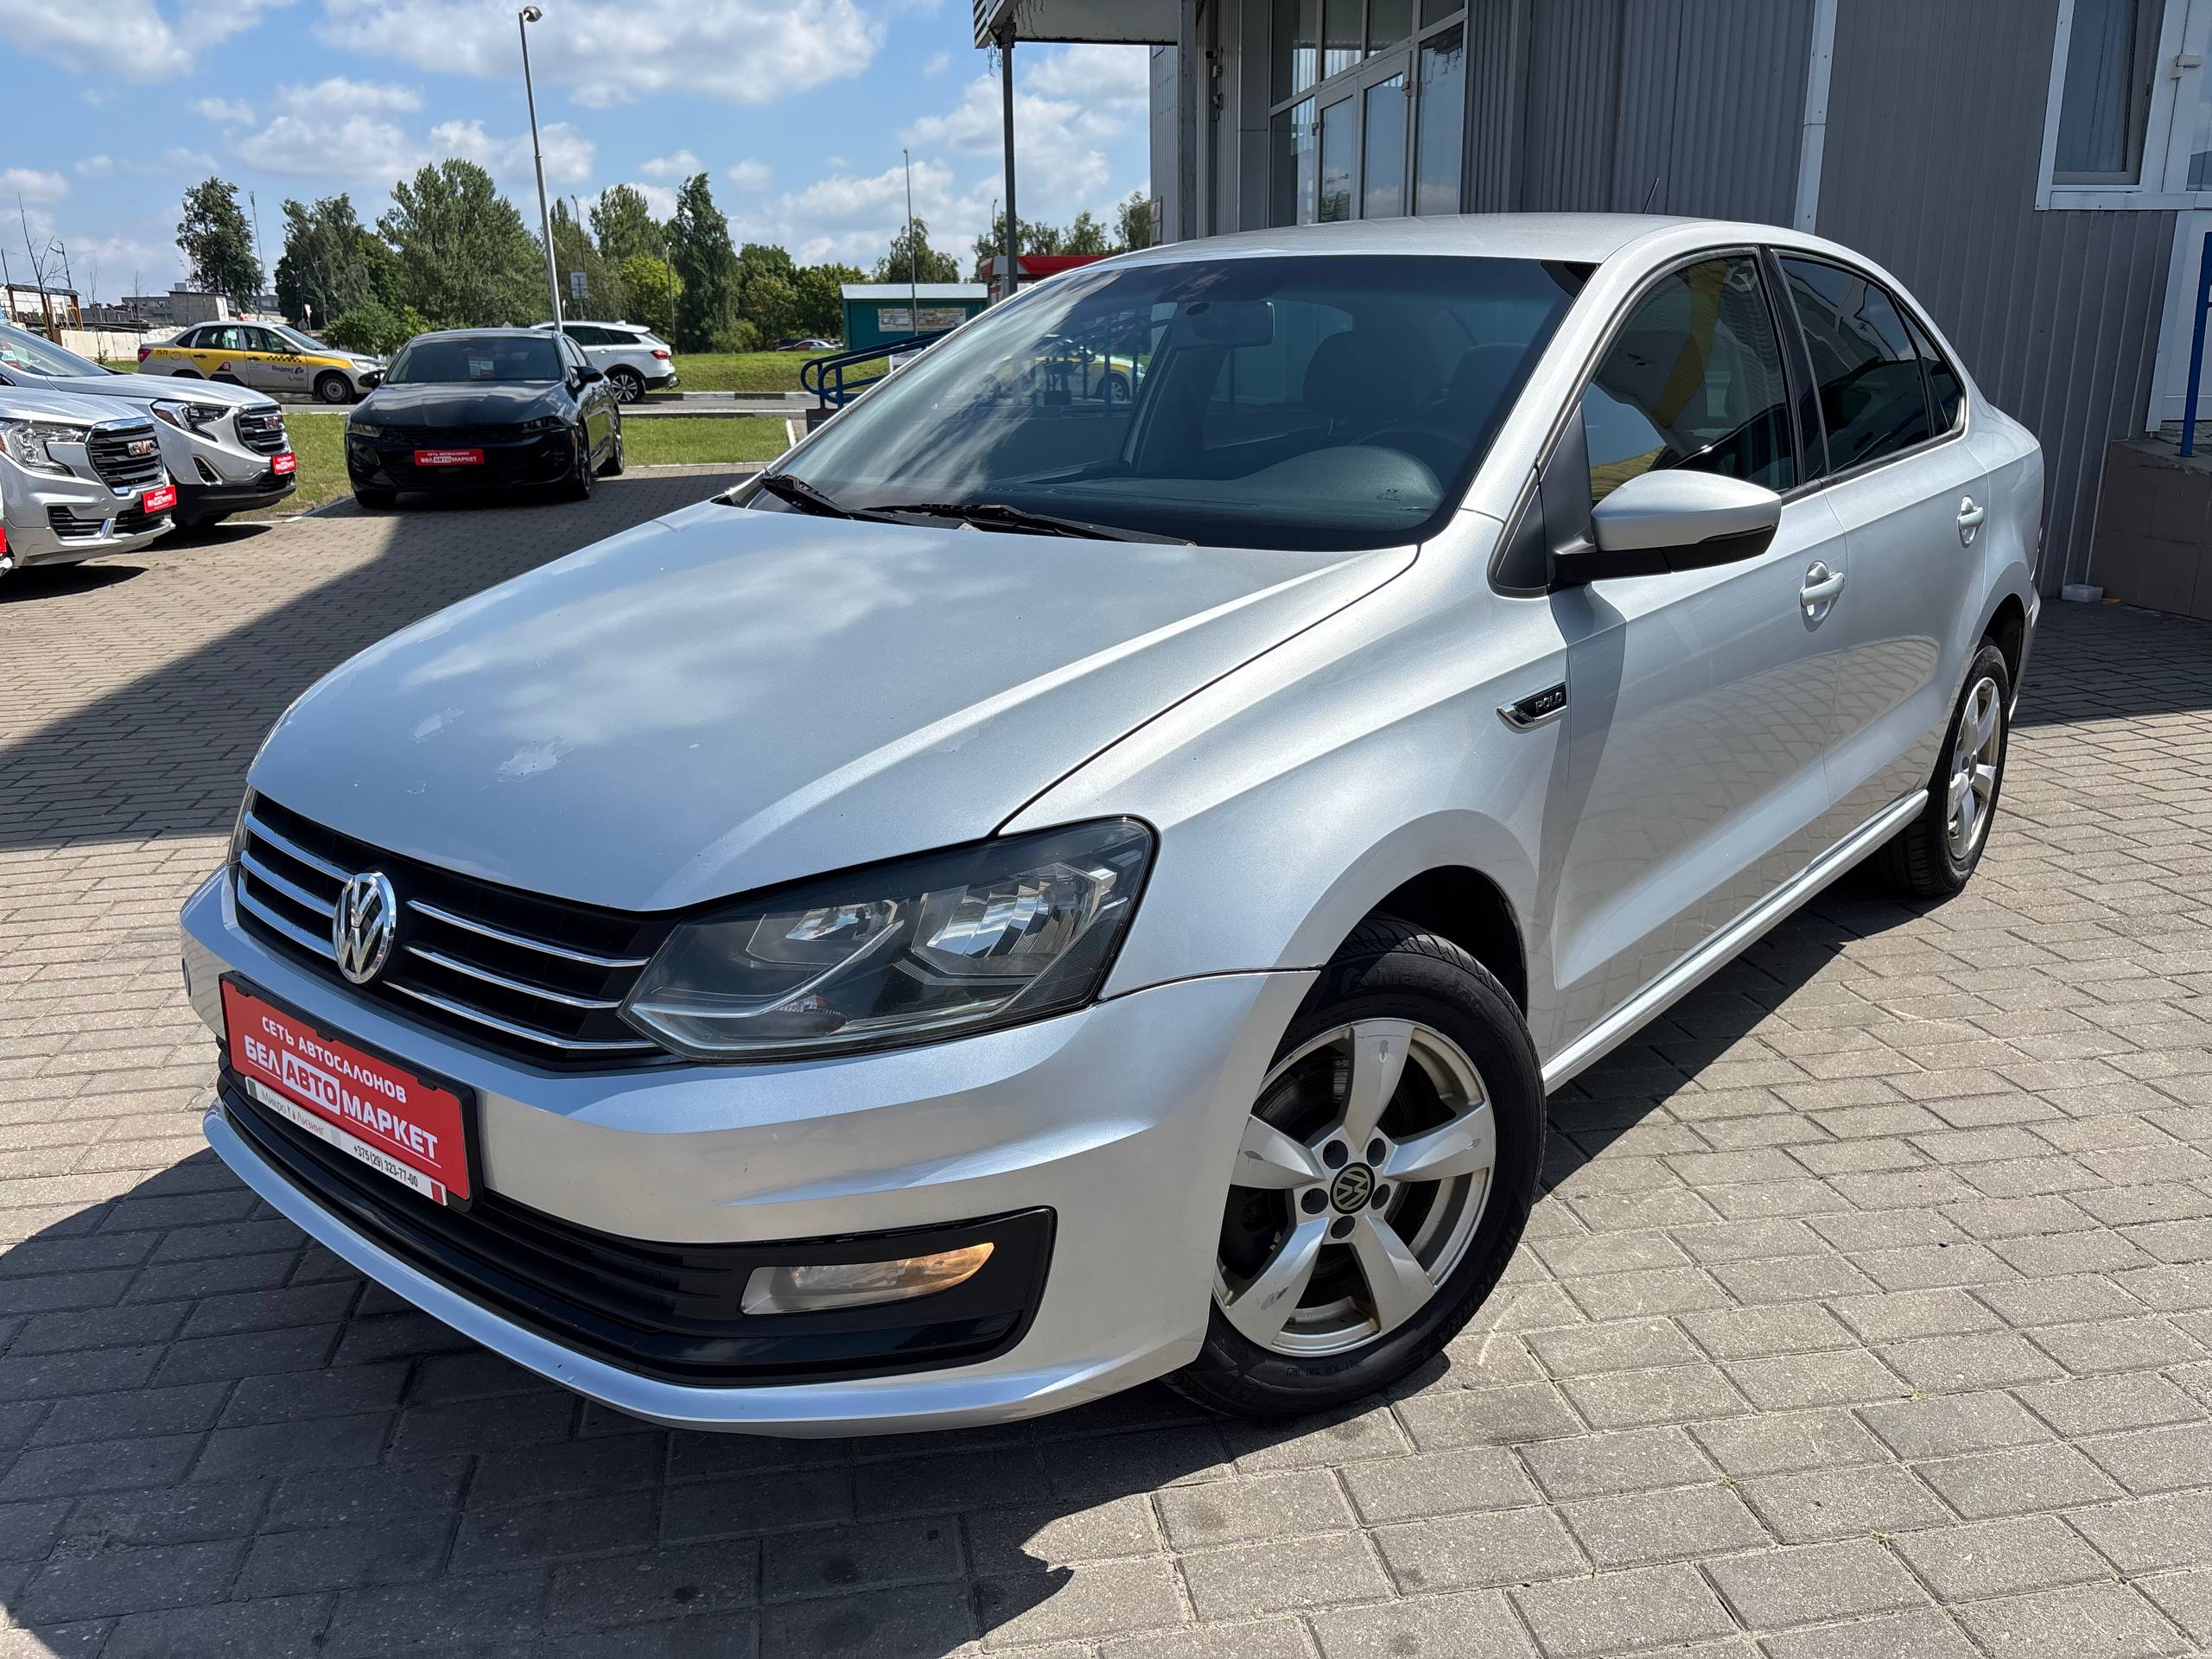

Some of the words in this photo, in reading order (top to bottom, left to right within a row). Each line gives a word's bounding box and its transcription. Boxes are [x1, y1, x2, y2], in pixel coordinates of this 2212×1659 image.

[1535, 691, 1562, 713] POLO
[262, 1015, 295, 1046] СЕТЬ
[299, 1036, 407, 1103] АВТОСАЛОНОВ
[384, 1160, 419, 1187] 323-77-00
